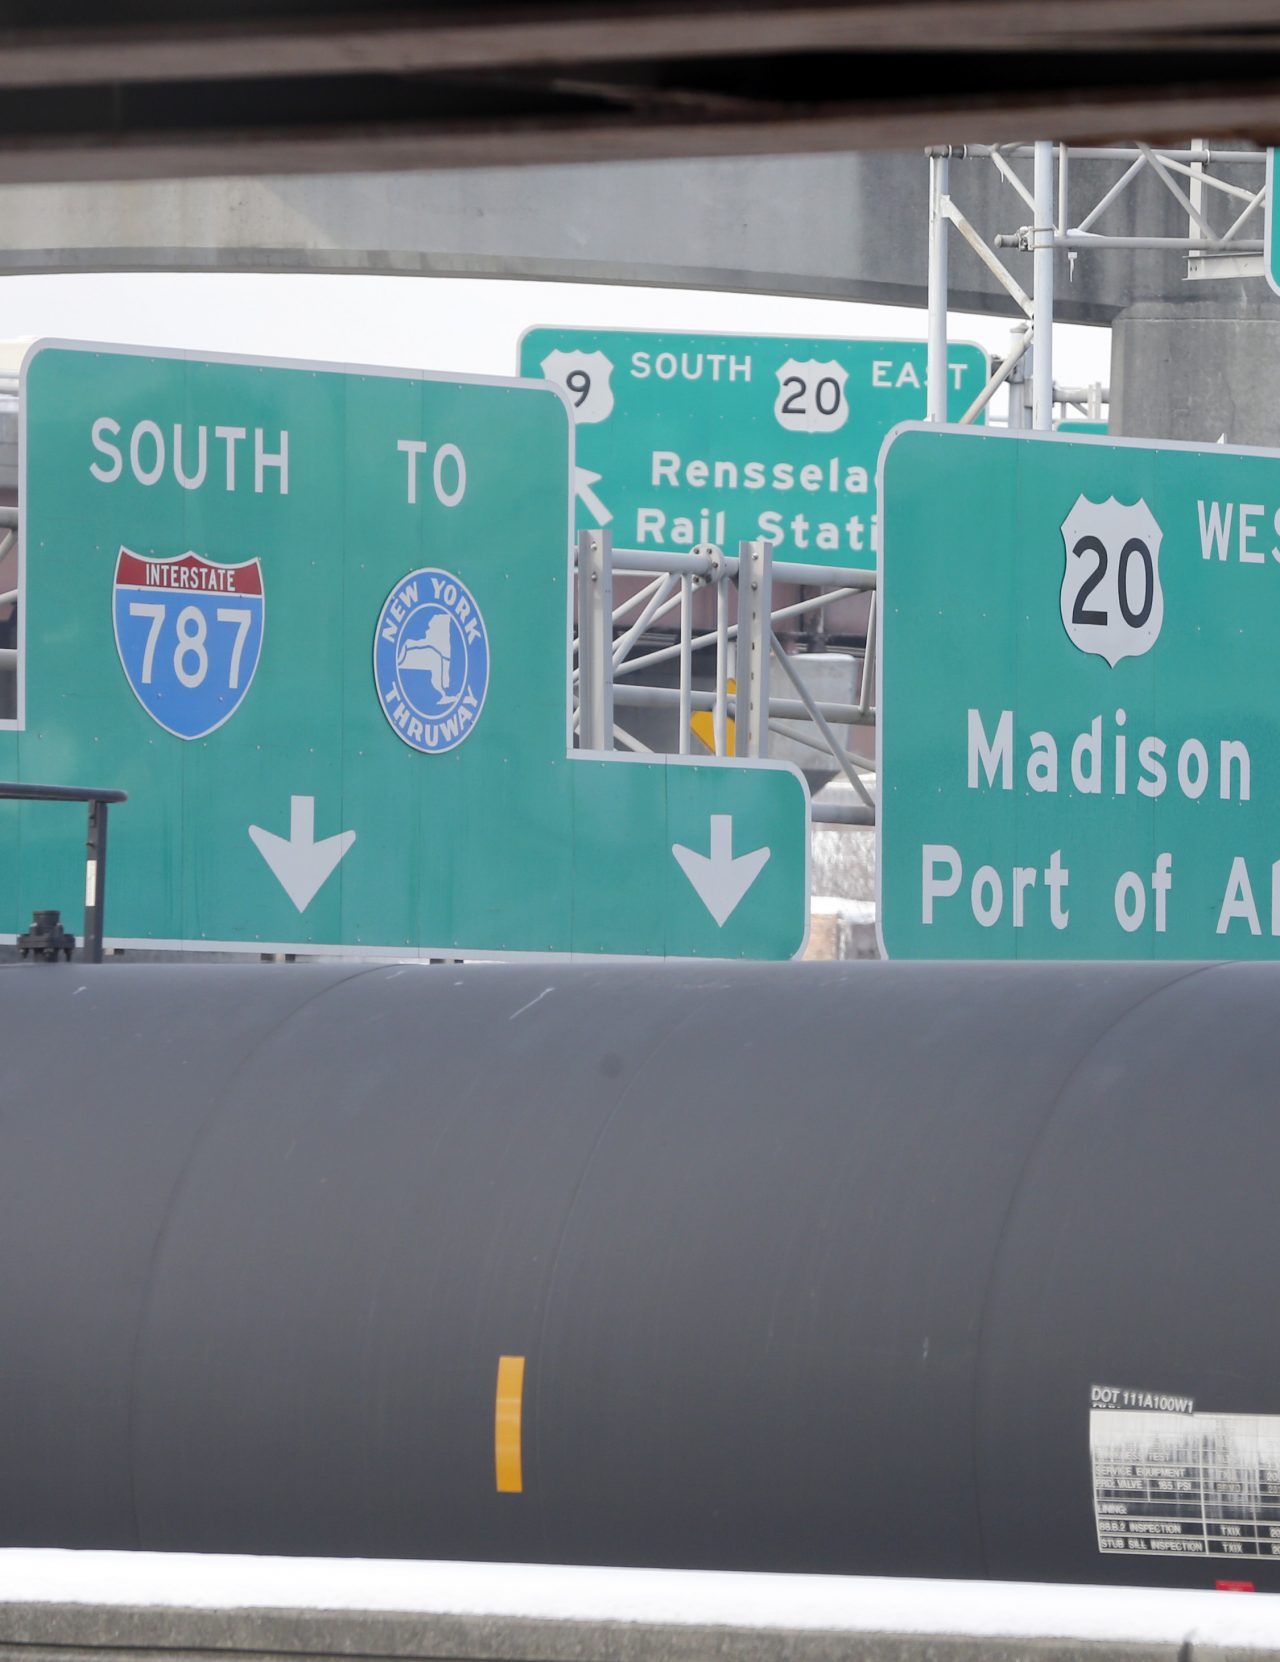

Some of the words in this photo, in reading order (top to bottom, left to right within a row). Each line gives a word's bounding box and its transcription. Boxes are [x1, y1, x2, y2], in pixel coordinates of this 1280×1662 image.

[565, 369, 591, 408] 9
[630, 351, 751, 382] SOUTH
[781, 375, 841, 415] 20
[872, 360, 968, 391] EAT
[89, 417, 289, 495] SOUTH
[397, 439, 467, 508] TO
[651, 451, 878, 494] Renssela
[636, 508, 726, 546] Rail
[146, 563, 236, 592] INTERSTATE
[1072, 535, 1154, 628] 20
[382, 581, 419, 643] NEW
[431, 577, 481, 645] YORK
[129, 602, 252, 689] 787
[385, 681, 479, 747] THRUWAY
[967, 708, 1251, 801] Madison
[921, 844, 1069, 930] Port
[1114, 853, 1173, 933] of
[1091, 1387, 1120, 1404] DOT
[1122, 1391, 1194, 1414] 111A100W1
[1117, 1480, 1143, 1489] VALVE
[1129, 1523, 1182, 1534] INSPECTION
[1150, 1540, 1203, 1551] INSPECTION
